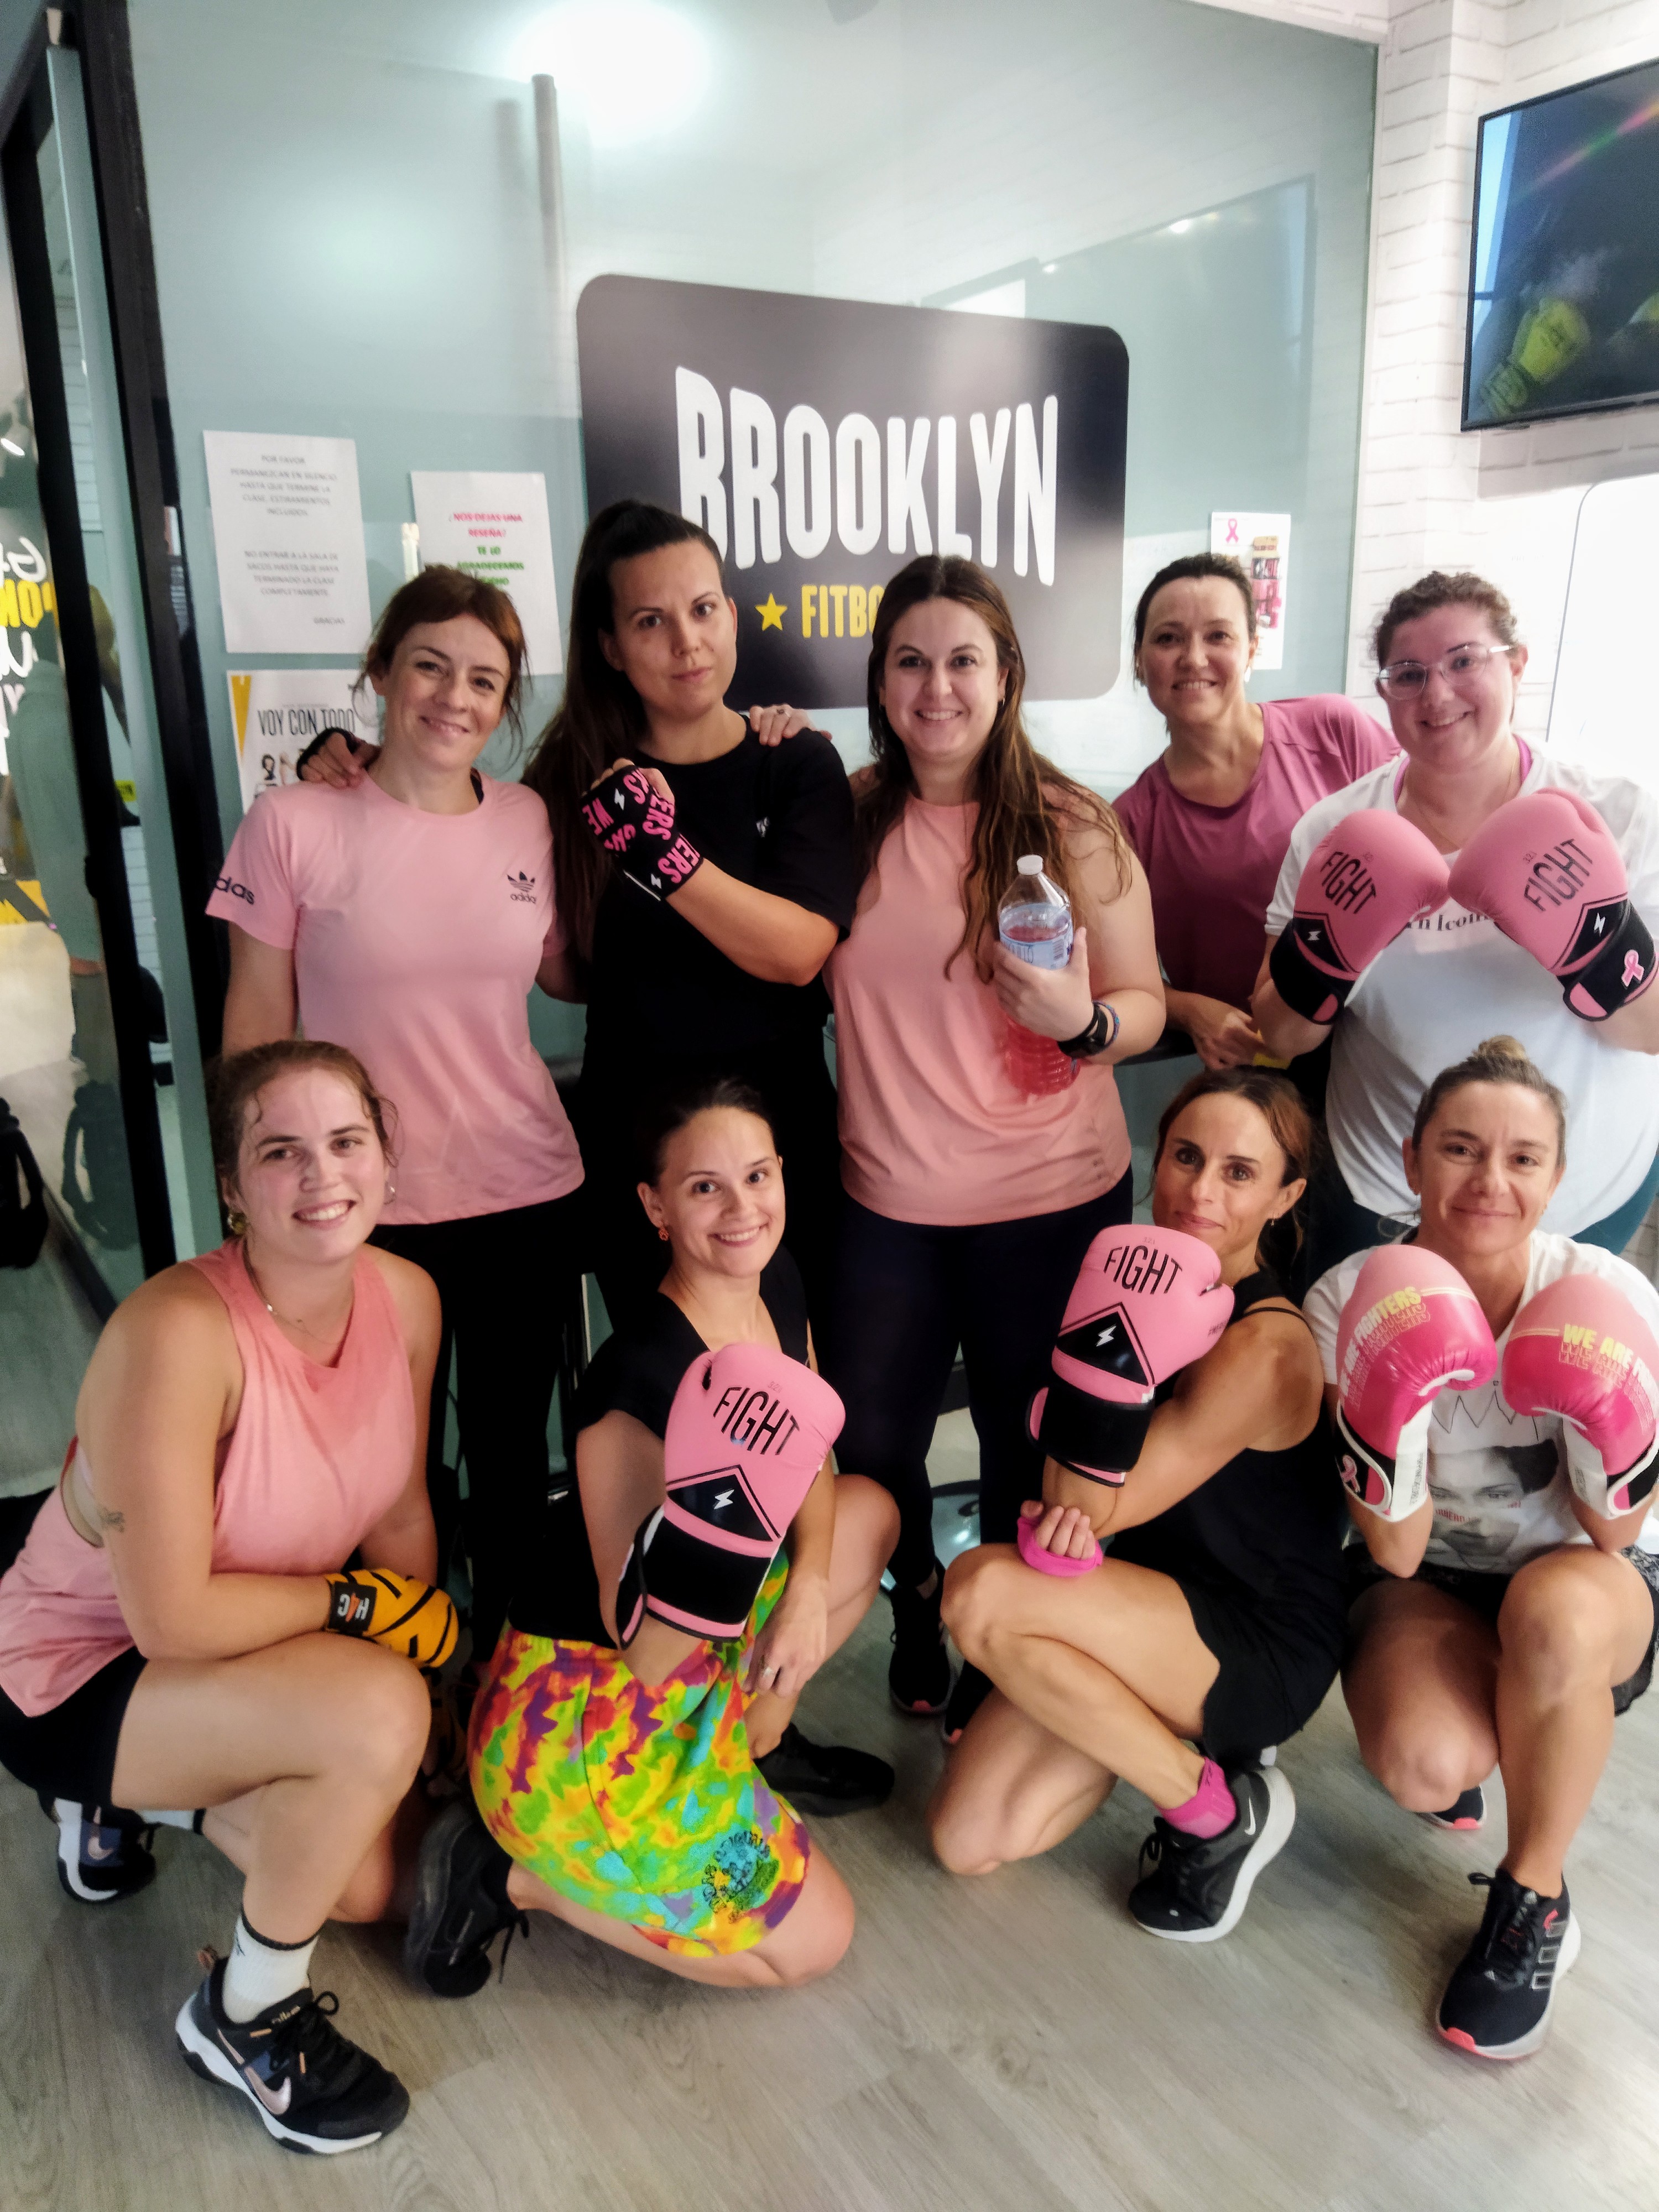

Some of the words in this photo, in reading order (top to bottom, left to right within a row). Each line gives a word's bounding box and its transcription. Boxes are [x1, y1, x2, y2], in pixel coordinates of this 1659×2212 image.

[675, 366, 1058, 587] BROOKLYN
[801, 584, 885, 638] FITBO
[258, 709, 283, 736] VOY
[288, 709, 319, 736] CON
[1320, 852, 1376, 915] FIGHT
[1524, 838, 1593, 912] FIGHT
[1103, 1245, 1183, 1295] FIGHT
[1563, 1323, 1597, 1350] WE
[1599, 1336, 1634, 1370] ARE
[713, 1386, 800, 1456] FIGHT
